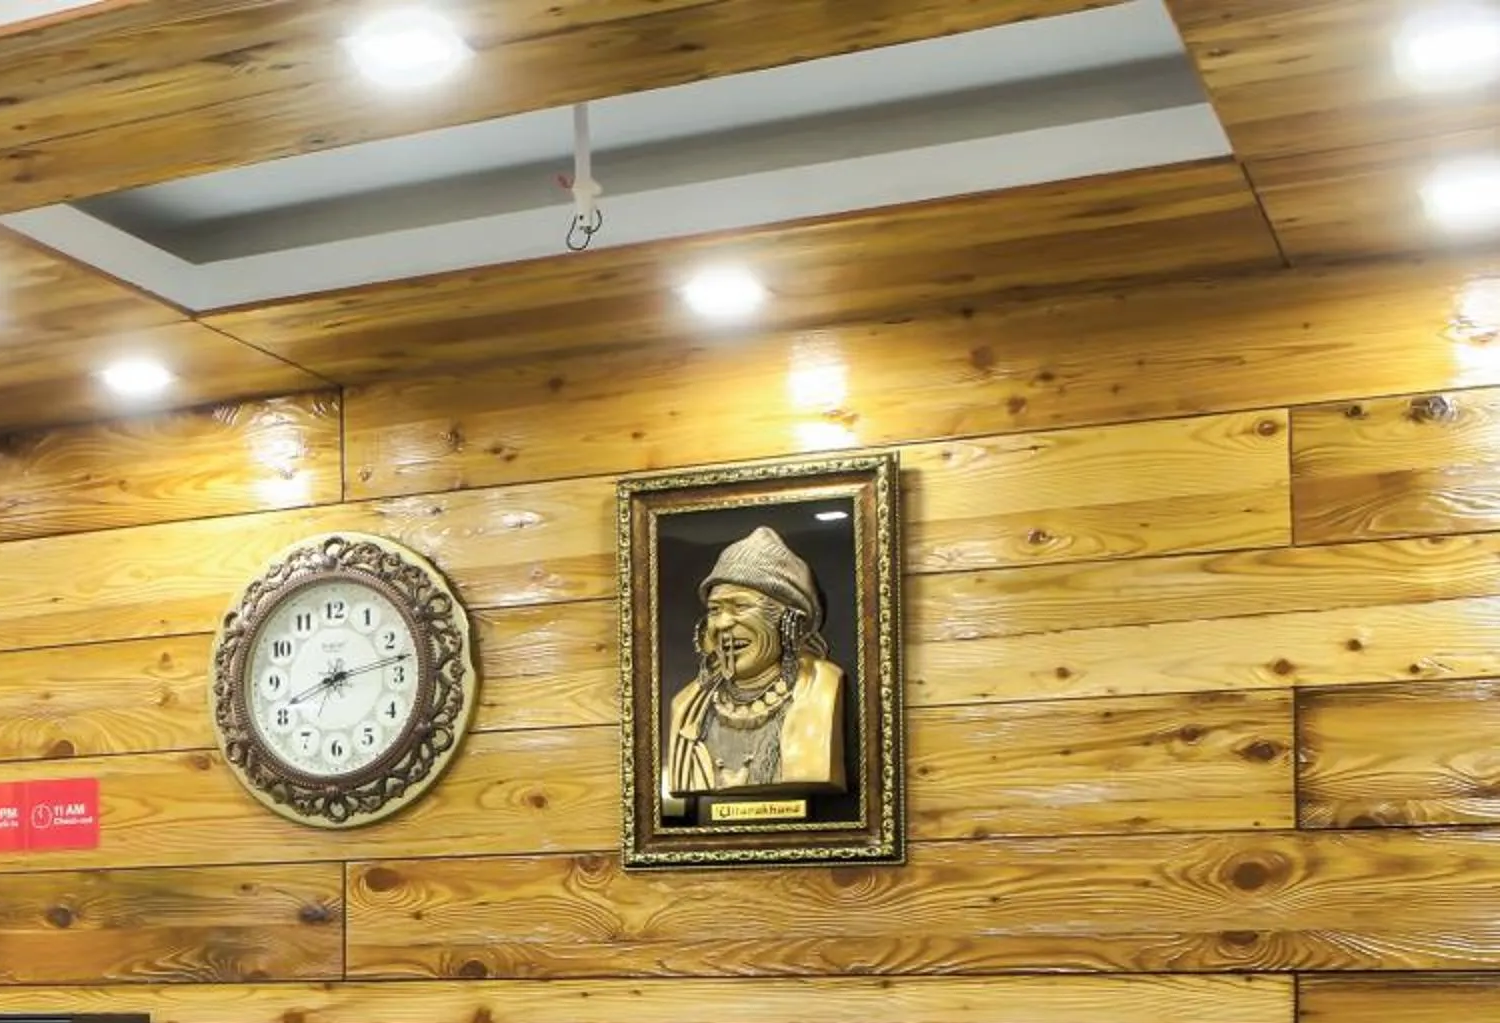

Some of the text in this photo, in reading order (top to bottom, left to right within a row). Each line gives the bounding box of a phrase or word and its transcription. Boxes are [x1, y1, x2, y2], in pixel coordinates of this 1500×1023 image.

[325, 601, 345, 619] 12
[362, 608, 372, 626] 1
[296, 613, 312, 632] 11
[272, 640, 291, 657] 10
[384, 632, 396, 649] 2
[269, 674, 280, 691] 9
[394, 666, 405, 683] 3
[277, 709, 289, 725] 8
[385, 700, 397, 718] 4
[300, 731, 311, 750] 7
[362, 728, 373, 745] 5
[331, 740, 342, 757] 6
[0, 808, 18, 819] PM
[54, 804, 85, 816] 11 AM
